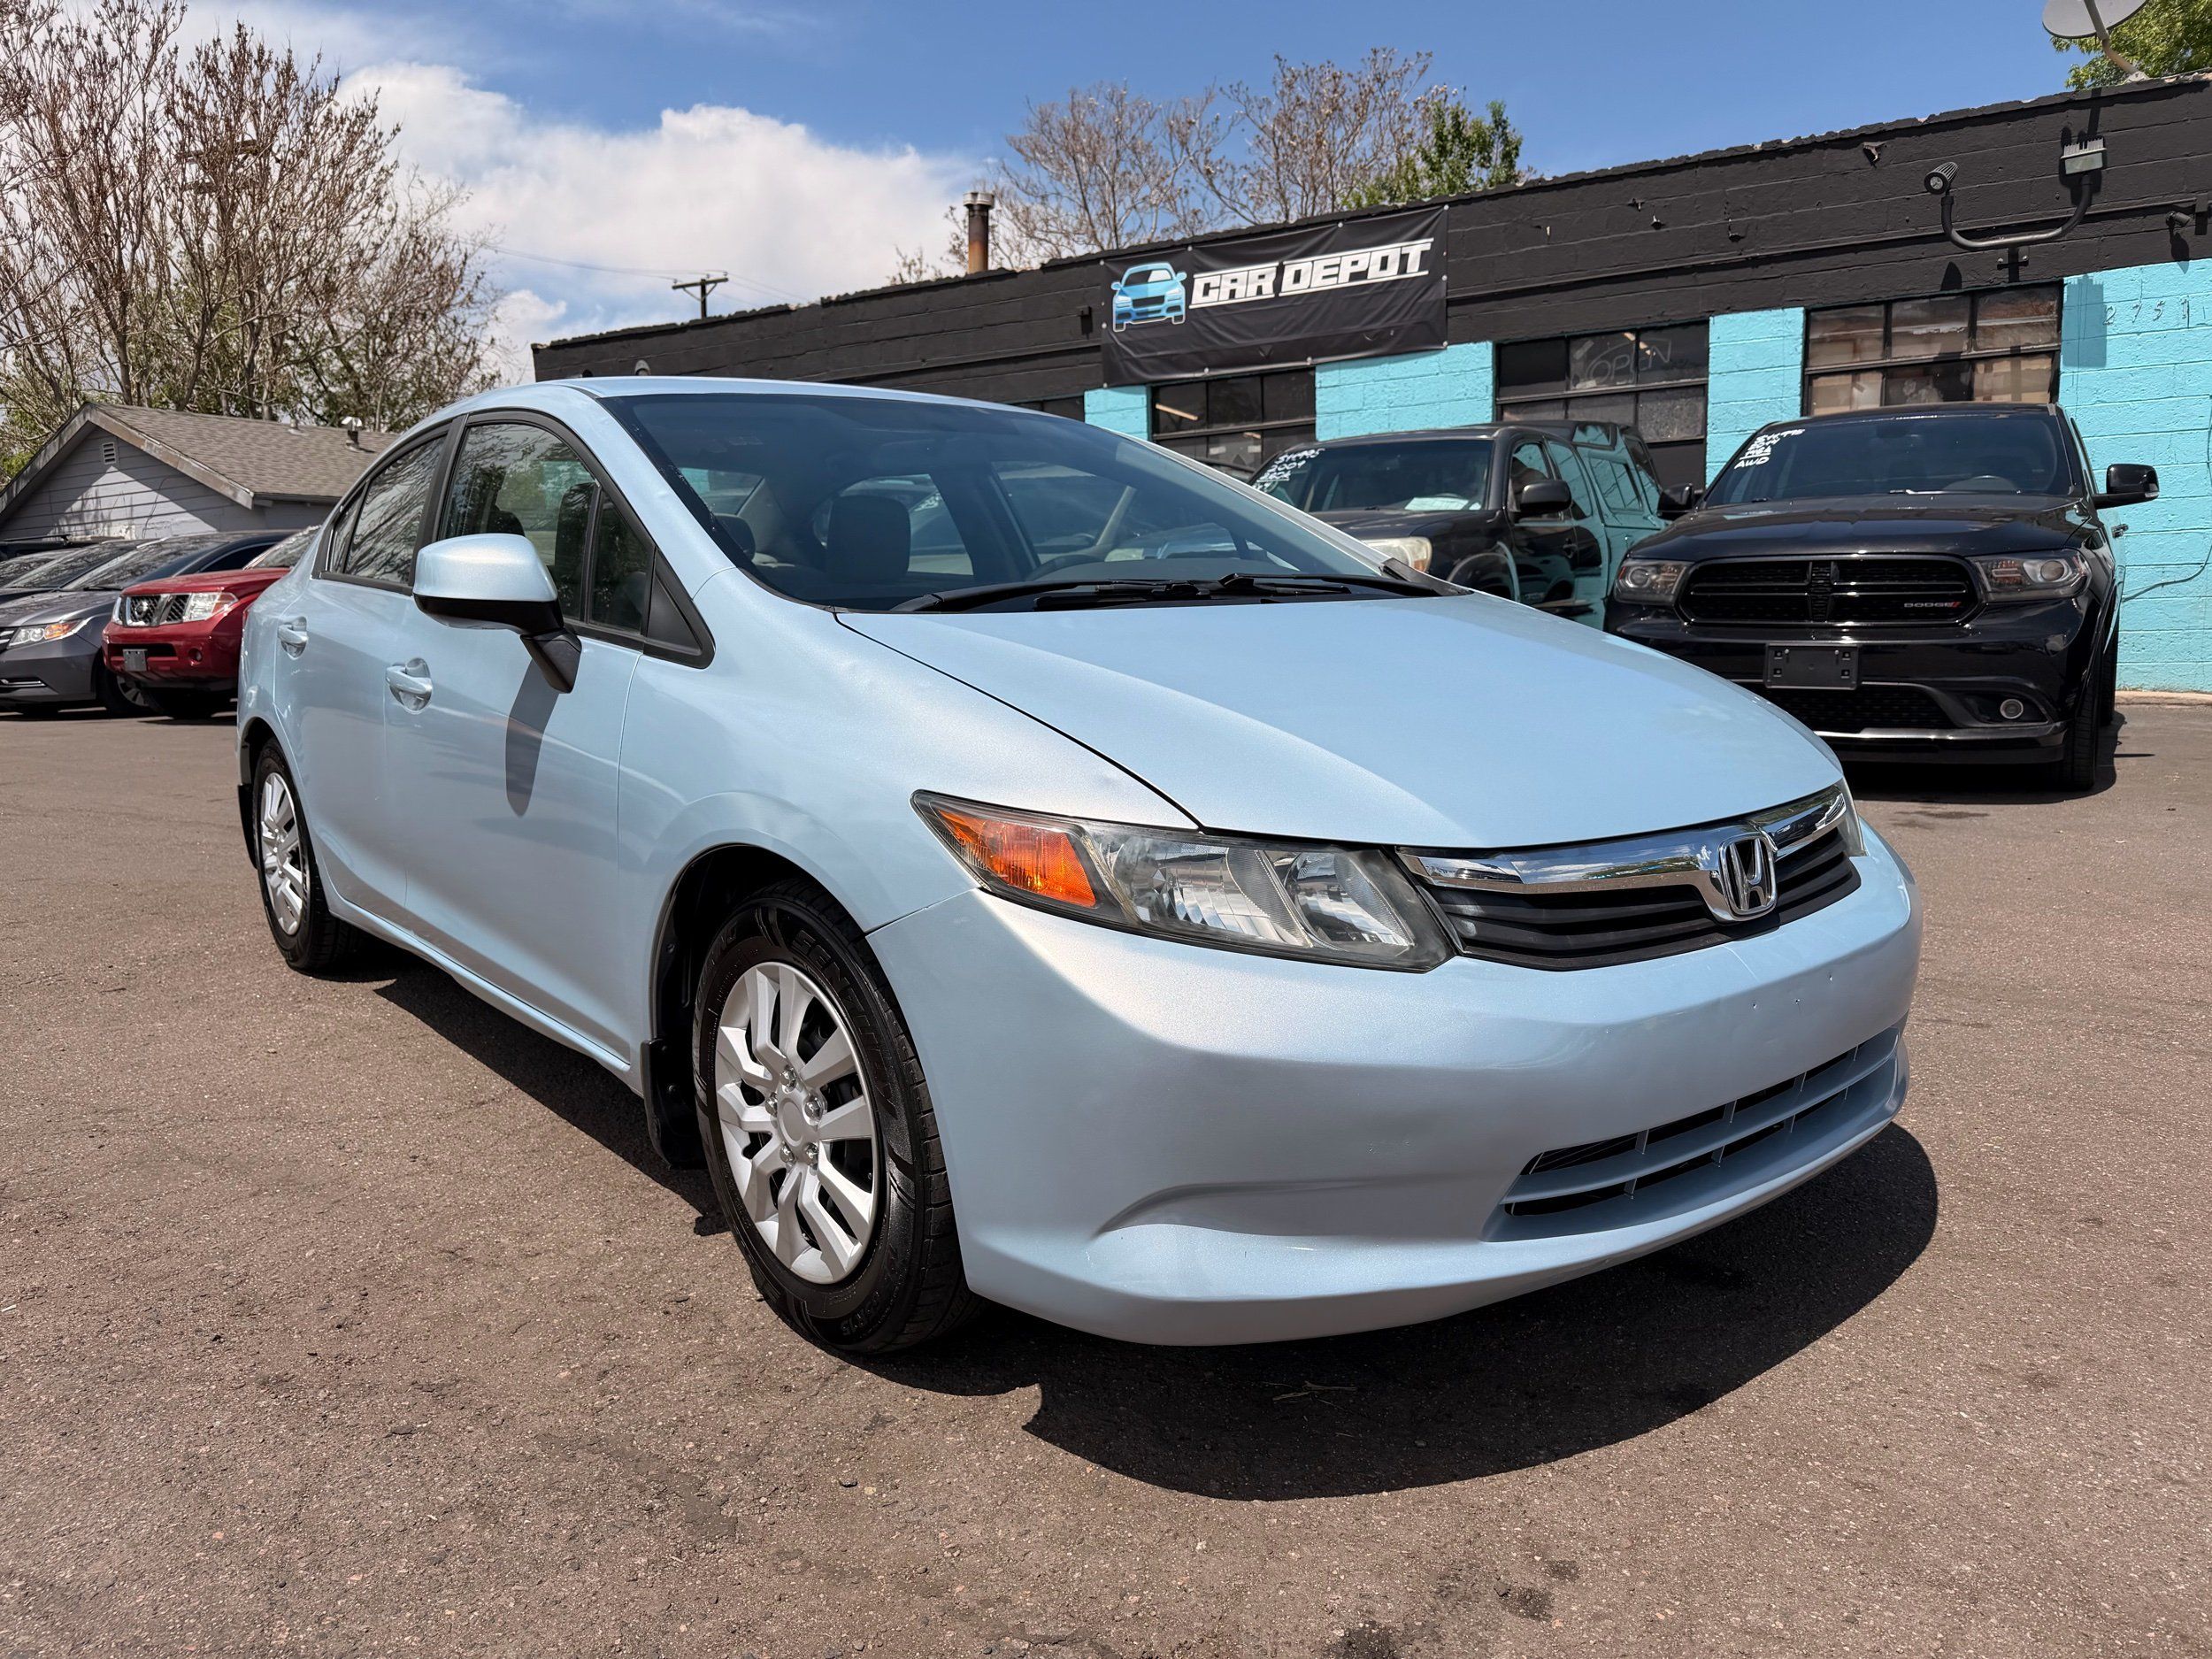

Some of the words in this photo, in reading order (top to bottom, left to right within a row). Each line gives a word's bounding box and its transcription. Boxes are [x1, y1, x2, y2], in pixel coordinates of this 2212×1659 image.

[1190, 266, 1278, 306] CAR
[1281, 242, 1432, 294] DEPOT
[2103, 297, 2190, 326] 2751
[1733, 457, 1770, 470] AWD
